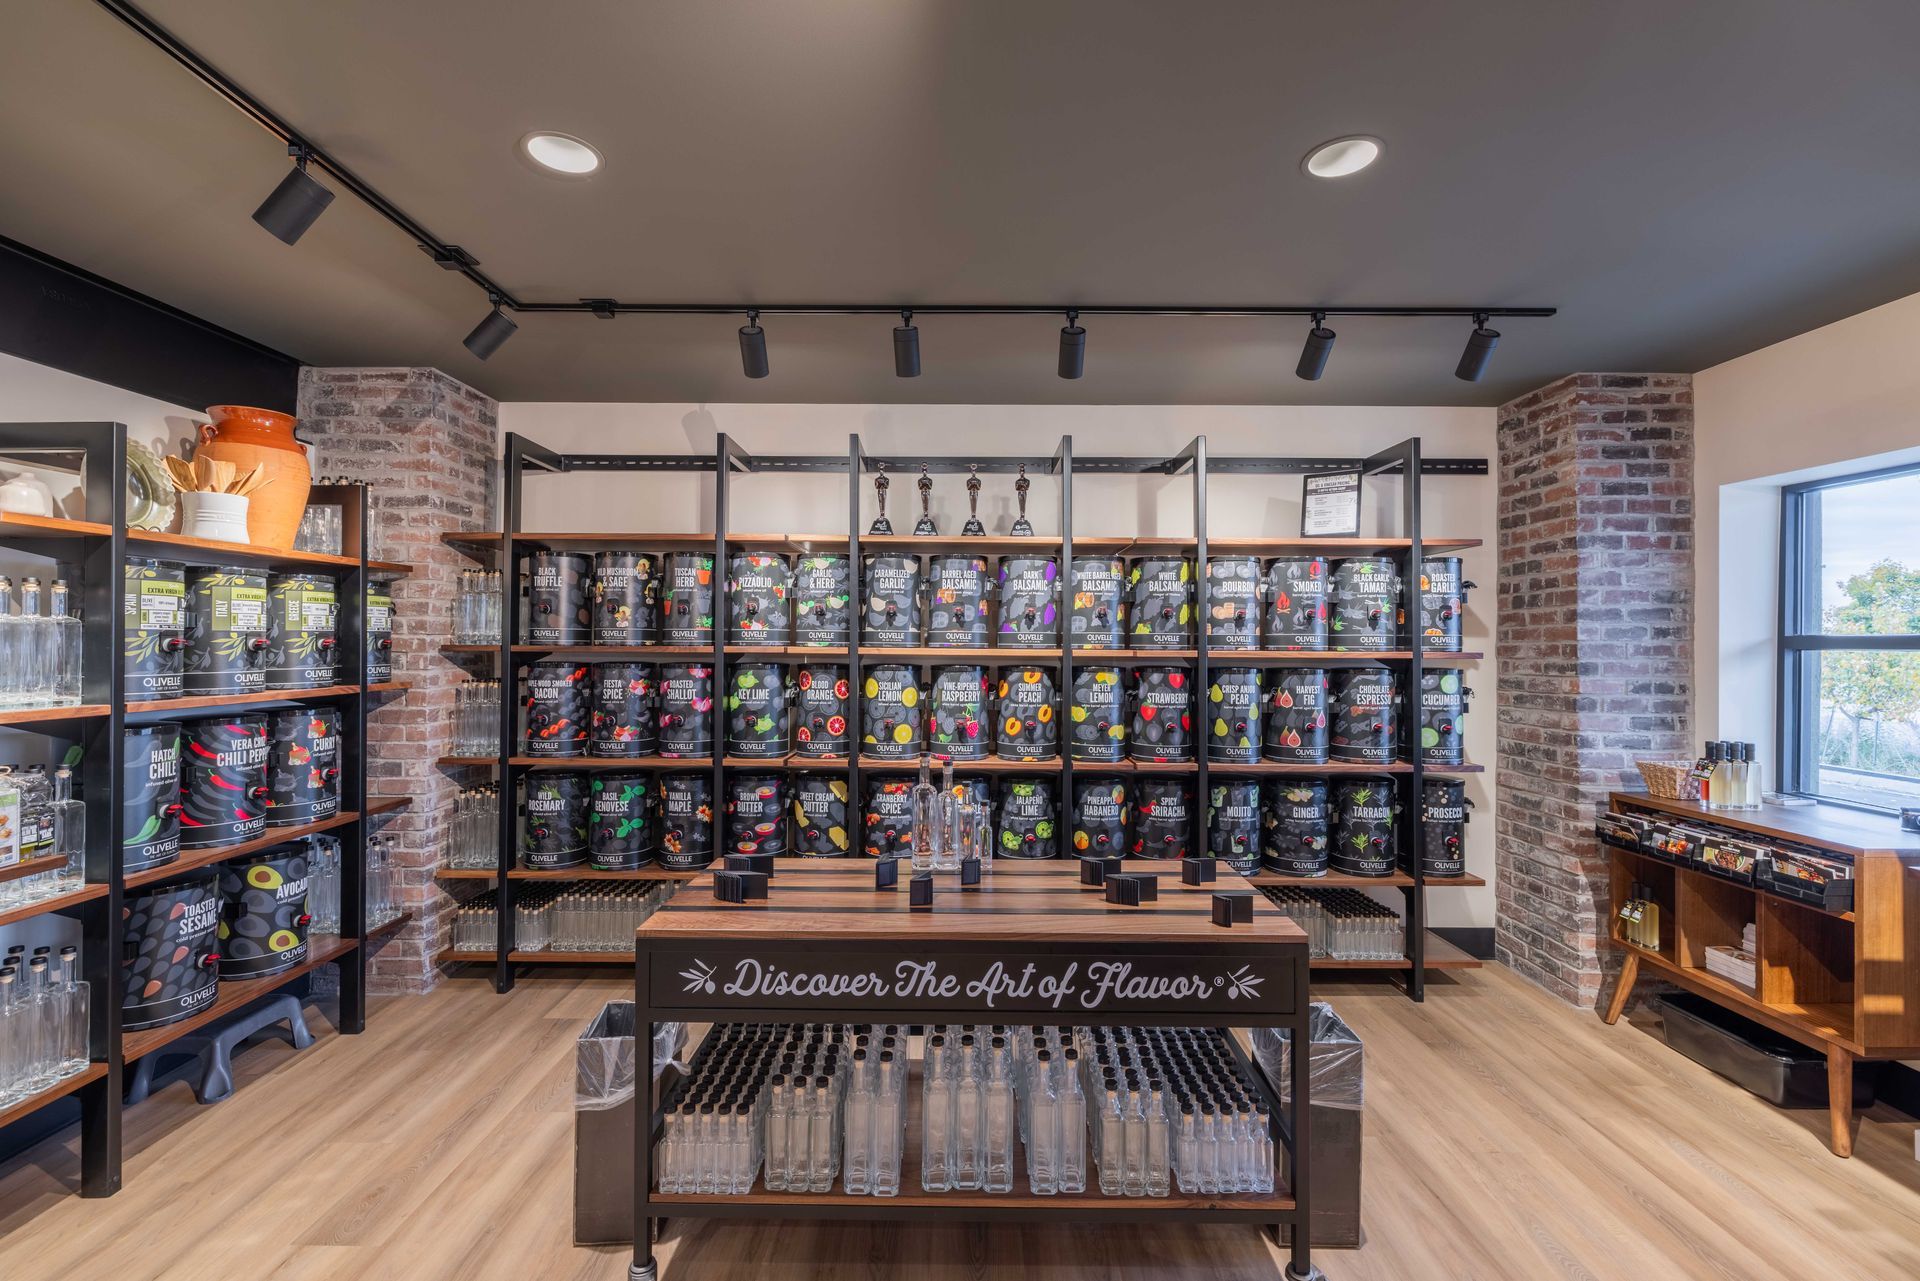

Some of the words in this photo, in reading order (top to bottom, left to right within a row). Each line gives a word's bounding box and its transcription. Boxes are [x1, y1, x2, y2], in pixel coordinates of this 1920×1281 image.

[942, 570, 962, 578] BARREL
[963, 570, 976, 578] AGED
[1024, 571, 1038, 579] DARK
[534, 576, 562, 587] TRUFFLE
[602, 577, 607, 587] &
[609, 577, 628, 587] SAGE
[676, 577, 694, 587] HERB
[739, 577, 772, 588] PIZZAOLIO
[810, 578, 815, 588] &
[816, 578, 835, 588] HERB
[880, 578, 904, 588] GARLIC
[942, 579, 976, 589] BALSAMIC
[1013, 580, 1048, 590] BALSAMIC
[1082, 581, 1116, 591] BALSAMIC
[1149, 581, 1183, 592] BALSAMIC
[1222, 582, 1254, 592] BOURBON
[1294, 582, 1322, 592] SMOKED
[1360, 582, 1387, 592] TAMARI
[1431, 582, 1456, 592] GARLIC
[125, 594, 136, 614] SPAIN
[216, 600, 228, 617] ITALY
[143, 677, 180, 687] OLIVELLE
[235, 674, 264, 682] OLIVELLE
[1018, 683, 1042, 691] SUMMER
[1222, 685, 1240, 693] CRISP
[1296, 686, 1320, 694] HARVEST
[1360, 686, 1389, 694] CHOCOLATE
[534, 688, 558, 698] BACON
[603, 689, 623, 699] SPICE
[667, 689, 697, 699] SHALLOT
[738, 689, 750, 699] KEY
[752, 689, 769, 699] LIME
[807, 690, 833, 700] ORANGE
[878, 691, 902, 701] LEMON
[942, 691, 980, 702] RASPBERRY
[1019, 692, 1042, 702] PEACH
[1090, 692, 1113, 703] LEMON
[1147, 693, 1188, 704] STRAWBERRY
[1231, 694, 1249, 704] PEAR
[1304, 695, 1314, 705] FIG
[1357, 695, 1391, 704] ESPRESSO
[1423, 695, 1460, 705] CUCUMBER
[232, 739, 252, 751] VERA
[314, 737, 335, 751] CURRY
[152, 748, 176, 763] HATCH
[217, 750, 248, 767] CHILI
[150, 761, 176, 779] CHILE
[538, 792, 552, 800] WILD
[669, 792, 691, 800] VANILLA
[740, 792, 759, 801] BROWN
[876, 794, 907, 802] CRANBERRY
[1088, 796, 1116, 804] PINEAPPLE
[1161, 797, 1177, 805] SPICY
[312, 799, 335, 811] OLIVELLE
[528, 800, 565, 811] ROSEMARY
[595, 801, 629, 812] GENOVESE
[668, 801, 692, 812] MAPLE
[737, 802, 763, 812] BUTTER
[803, 802, 828, 812] BUTTER
[882, 803, 901, 813] SPICE
[1022, 805, 1038, 815] LIME
[1084, 805, 1118, 815] HABANERO
[1151, 806, 1185, 817] SRIRACHA
[1227, 806, 1252, 816] MOJITO
[1293, 807, 1319, 818] GINGER
[1353, 806, 1390, 818] TARRAGON
[1428, 807, 1462, 818] PROSECCO
[234, 818, 264, 832] OLIVELLE
[143, 839, 178, 855] OLIVELLE
[184, 898, 216, 918] TOASTED
[179, 909, 216, 935] SESAME
[281, 943, 307, 960] OLIVELLE
[723, 958, 889, 997] Discover
[895, 960, 960, 997] The
[966, 961, 1035, 1008] Art
[1039, 961, 1078, 1008] of
[181, 984, 216, 1006] OLIVELLE
